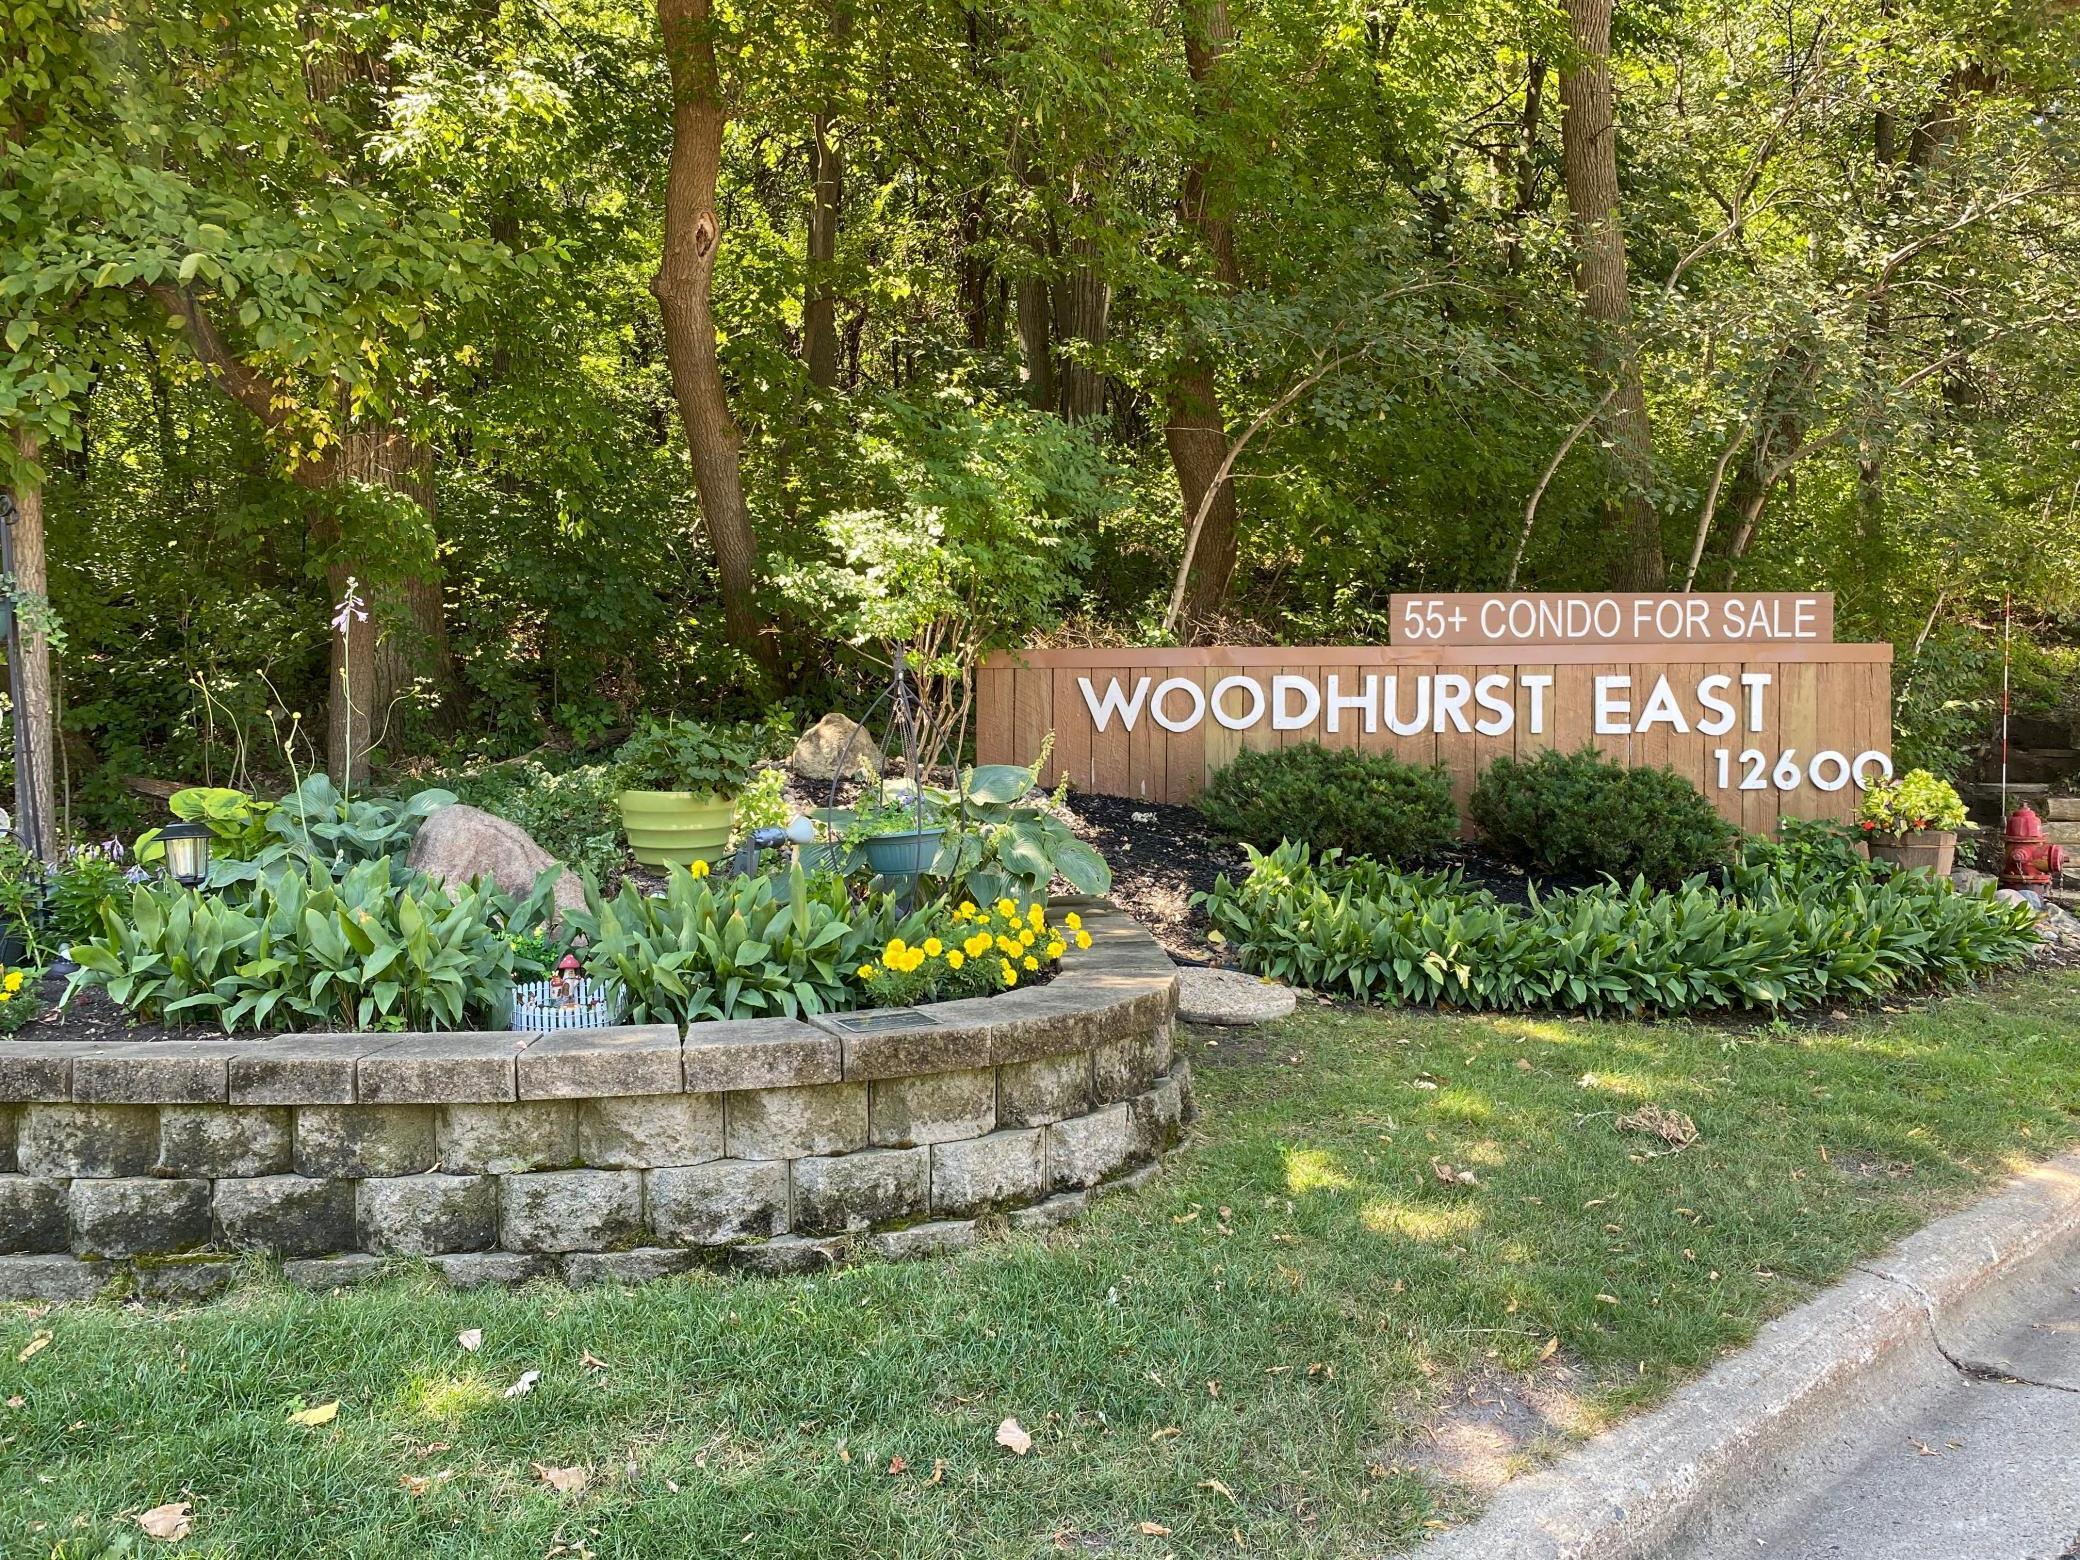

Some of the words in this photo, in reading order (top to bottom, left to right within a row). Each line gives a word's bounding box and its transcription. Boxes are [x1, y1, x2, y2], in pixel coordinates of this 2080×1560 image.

[1404, 600, 1468, 640] 55+
[1480, 599, 1622, 639] CONDO
[1632, 600, 1711, 639] FOR
[1722, 600, 1817, 640] SALE
[1076, 674, 1553, 736] WOODHURST
[1595, 673, 1772, 736] EAST
[1714, 748, 1894, 792] 12600
